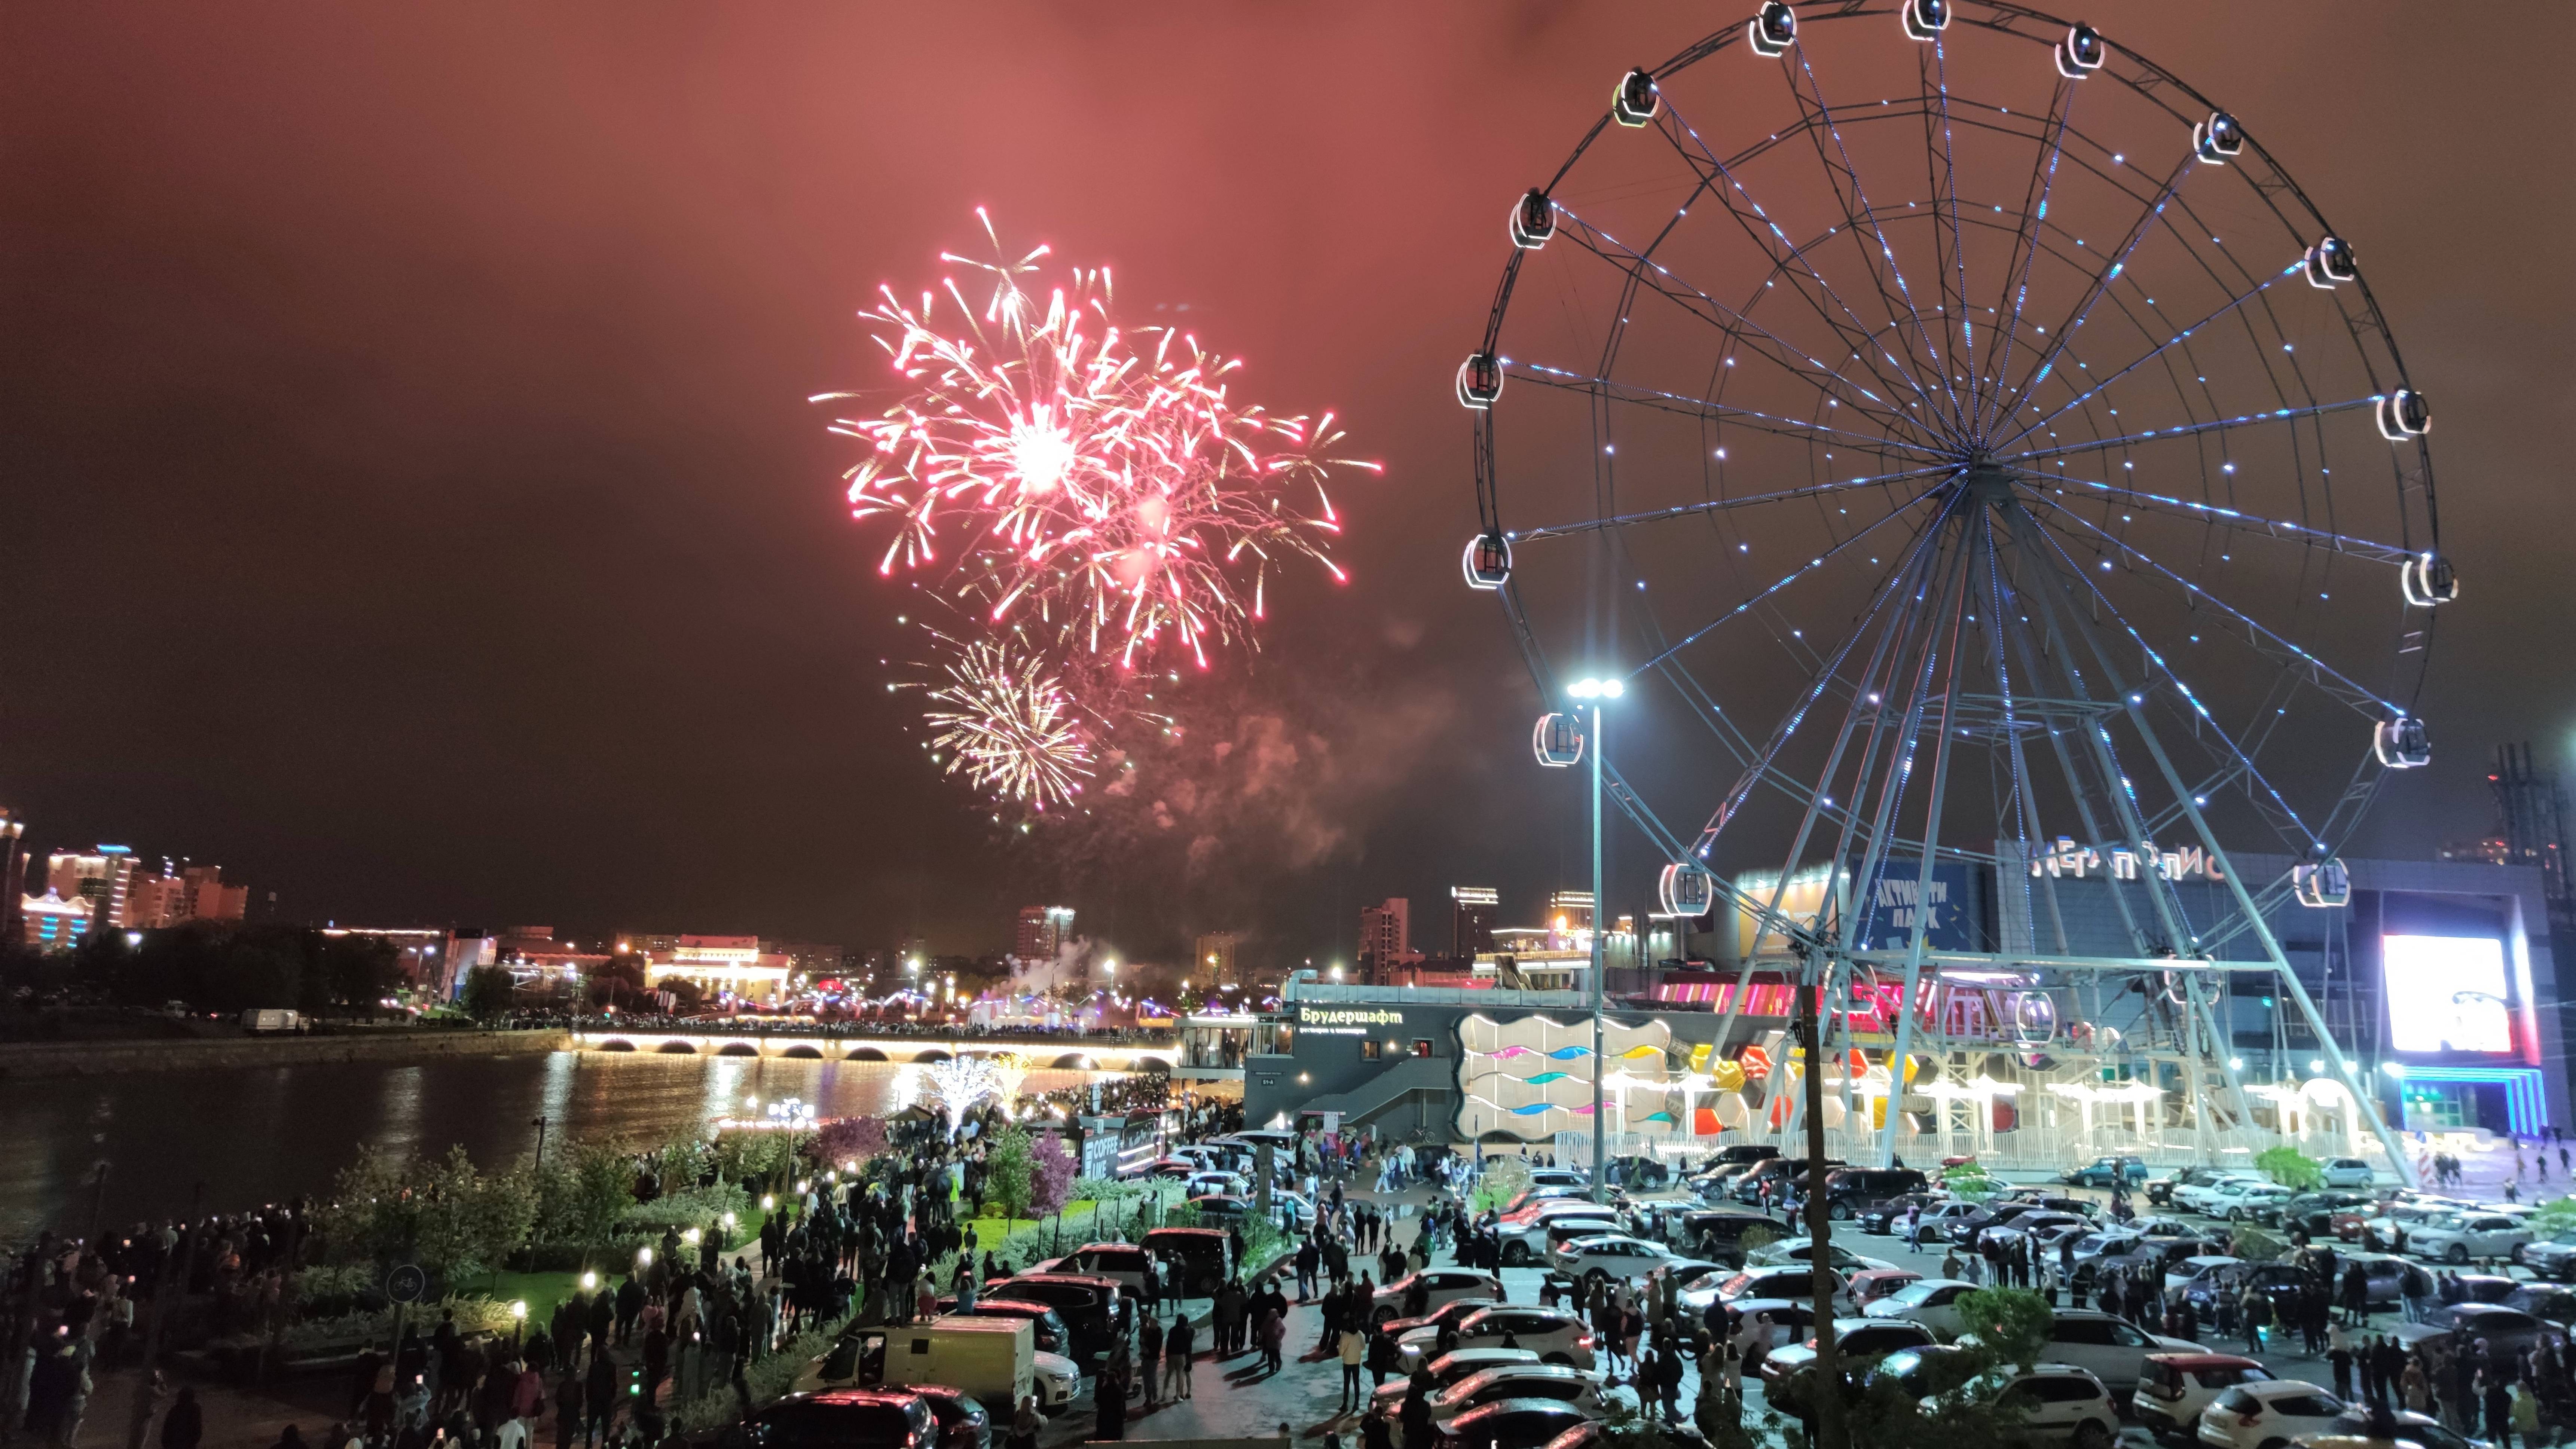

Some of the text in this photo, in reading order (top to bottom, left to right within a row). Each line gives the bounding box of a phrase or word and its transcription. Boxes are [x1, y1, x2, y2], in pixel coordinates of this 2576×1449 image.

[1874, 878, 1947, 907] АКТИВТИ
[1892, 907, 1940, 929] ПАК
[1300, 1007, 1403, 1025] Брудершафт
[1094, 1135, 1118, 1159] COFFEE
[1093, 1160, 1107, 1181] LIKE
